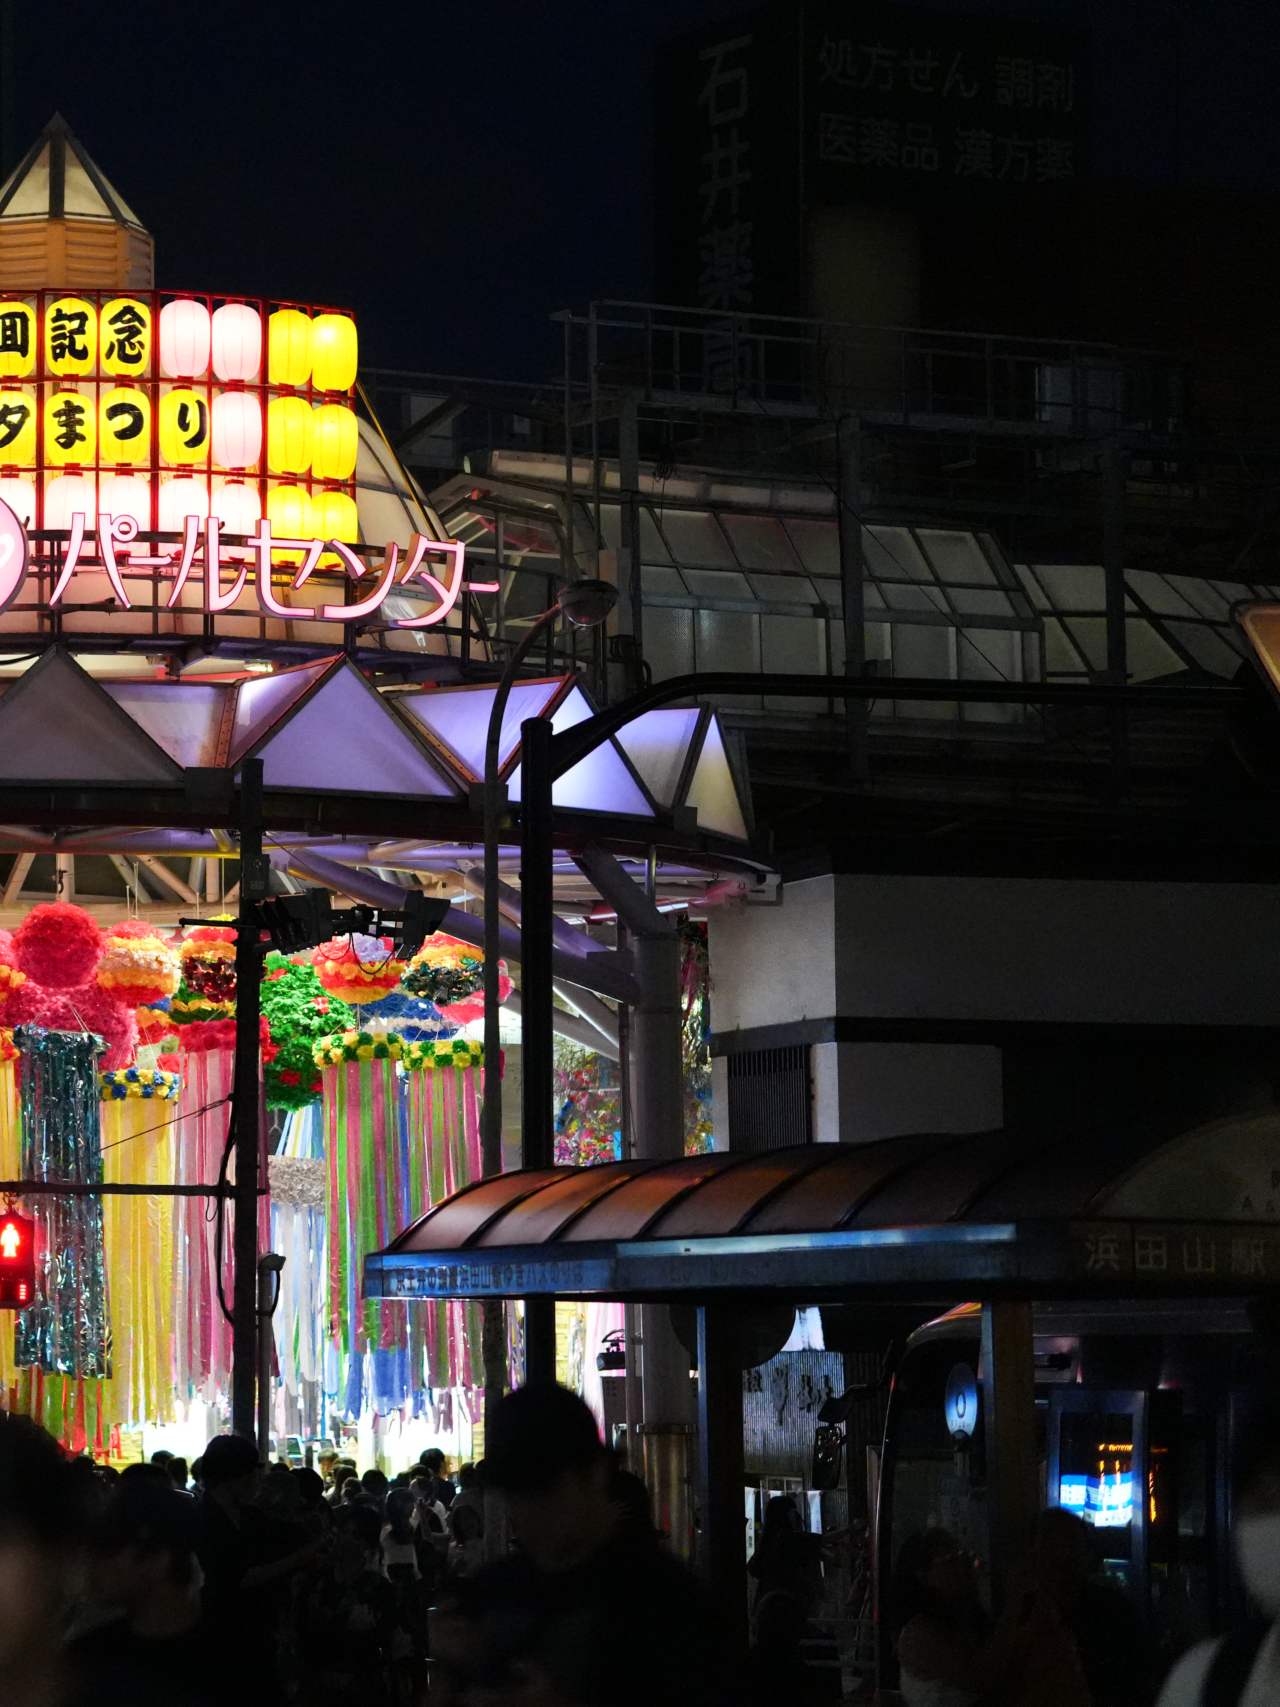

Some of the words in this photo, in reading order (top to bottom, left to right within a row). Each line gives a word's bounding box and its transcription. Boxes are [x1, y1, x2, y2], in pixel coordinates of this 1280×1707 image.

[819, 35, 979, 100] 処方せん
[994, 56, 1075, 113] 調剤
[819, 112, 940, 172] 医薬品
[953, 127, 1076, 184] 漢方薬
[49, 512, 501, 628] パールセンター
[1084, 1233, 1268, 1276] 浜田山駅
